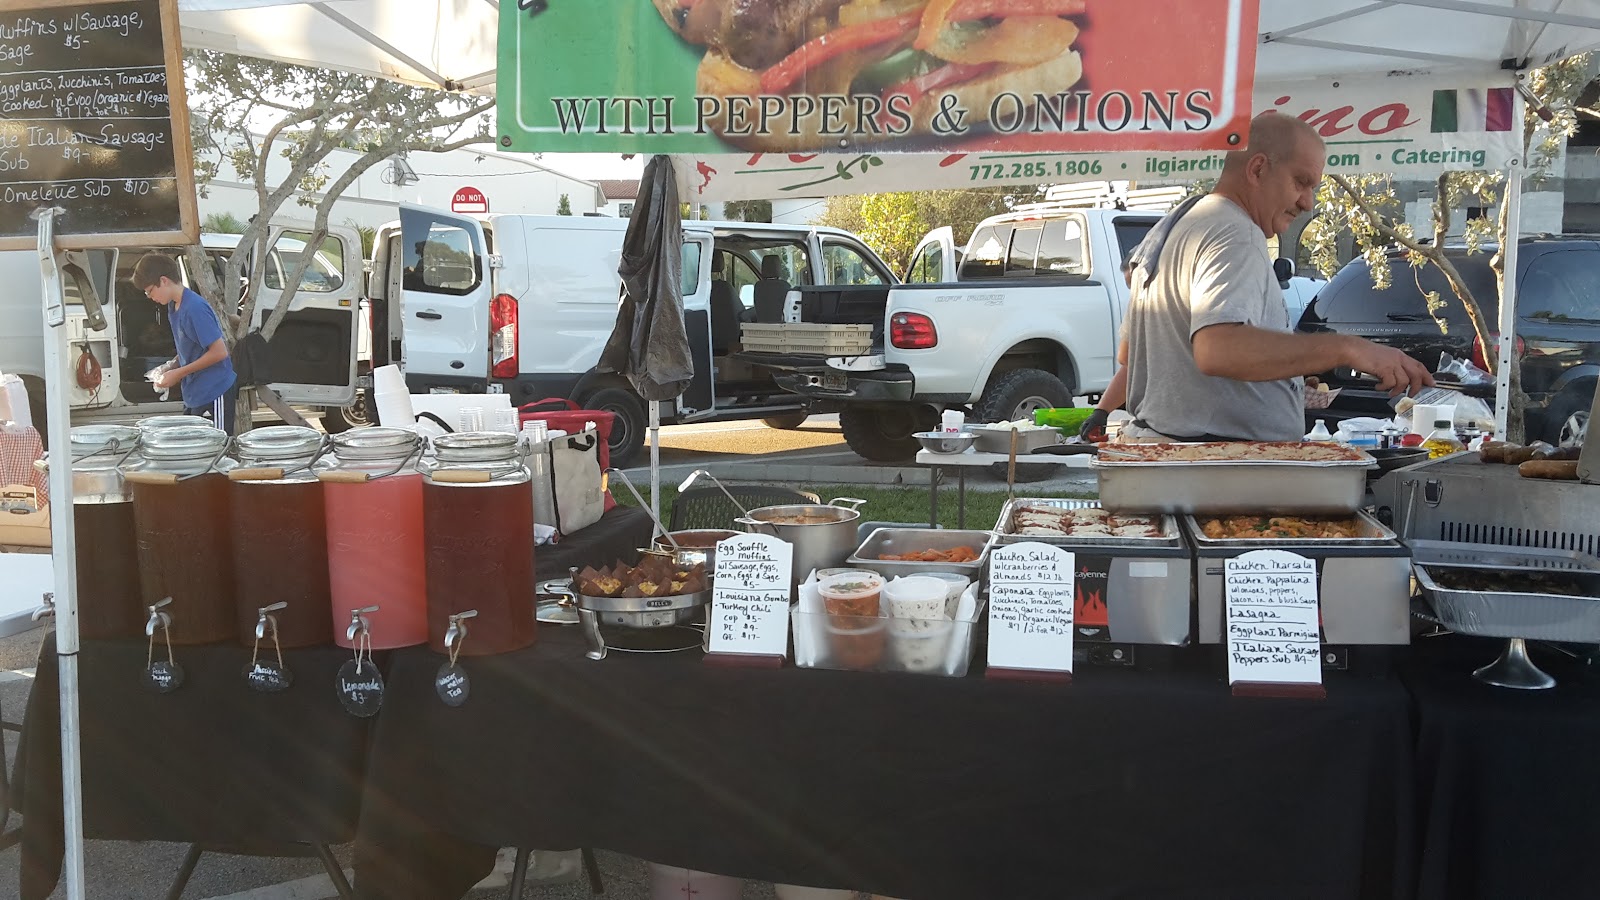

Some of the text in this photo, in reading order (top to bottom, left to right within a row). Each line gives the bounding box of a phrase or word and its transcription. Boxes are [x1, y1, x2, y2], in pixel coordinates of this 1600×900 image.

[0, 44, 34, 66] Sage
[0, 72, 166, 102] ggplants, Zucchinis, Tomatoes,
[51, 94, 65, 107] in
[551, 90, 1213, 136] WITH PEPPERS & ONIONS
[27, 126, 91, 147] Italian
[96, 124, 165, 150] Sausage
[0, 151, 29, 171] Sub
[969, 159, 1103, 180] 772.285.1806
[1392, 146, 1486, 167] Catering
[84, 181, 111, 197] Sub
[718, 542, 735, 556] Egg
[994, 551, 1059, 562] Chicken Salad
[1228, 560, 1269, 570] Chicken
[1074, 571, 1108, 579] cayenne
[1228, 576, 1264, 584] Chicken
[992, 585, 1035, 596] Caponata
[719, 603, 771, 616] Turkey Chili
[1230, 607, 1281, 622] Lasagna
[1232, 642, 1284, 653] Italian
[1233, 653, 1269, 666] Peppers
[1272, 654, 1291, 664] Sub
[342, 678, 380, 694] Lemonade
